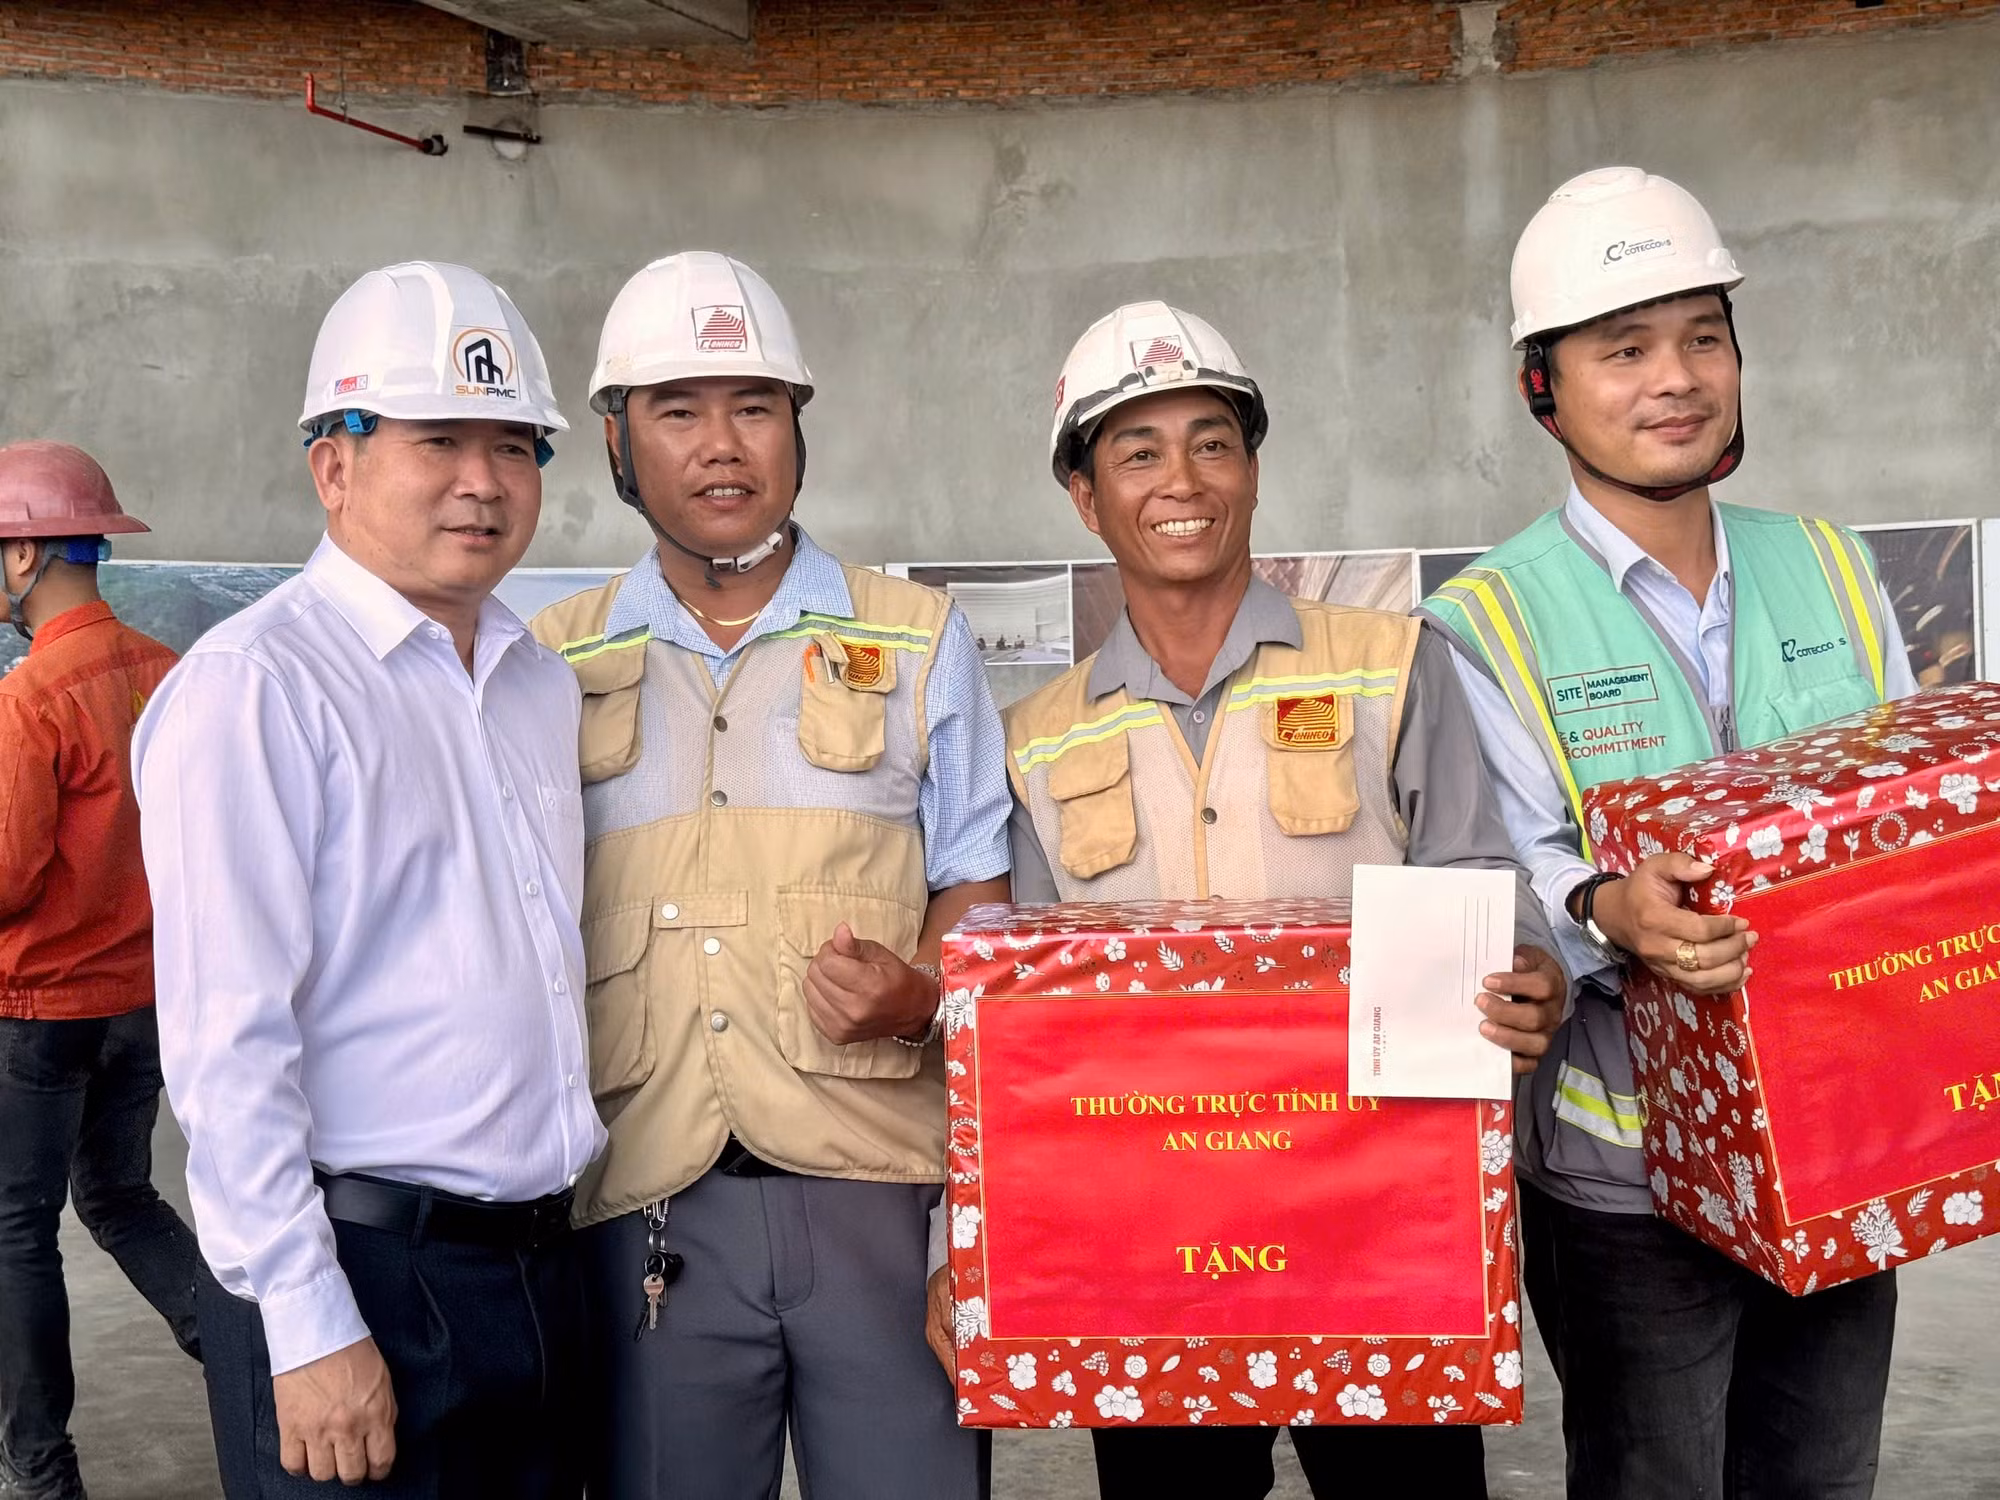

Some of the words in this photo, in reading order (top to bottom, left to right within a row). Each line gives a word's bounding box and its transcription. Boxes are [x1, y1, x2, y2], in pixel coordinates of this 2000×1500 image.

[455, 385, 517, 399] SUNPMC
[1530, 368, 1545, 394] 3M
[1796, 637, 1847, 658] COTECCOS
[1586, 673, 1650, 690] MANAGEMENT
[1556, 687, 1584, 702] SITE
[1588, 688, 1622, 701] BOARD
[1569, 731, 1580, 743] &
[1582, 721, 1644, 741] QUALITY
[1571, 735, 1667, 760] COMMITMENT
[1828, 945, 1933, 991] THƯỜNG
[1919, 976, 1950, 1003] AN
[1954, 960, 2000, 990] GIA
[1071, 1090, 1186, 1117] THƯỜNG
[1192, 1090, 1266, 1119] TRỰC
[1272, 1087, 1339, 1112] TỈNH
[1162, 1131, 1198, 1151] AN
[1205, 1130, 1293, 1151] GIANG
[1175, 1241, 1289, 1281] TẶNG
